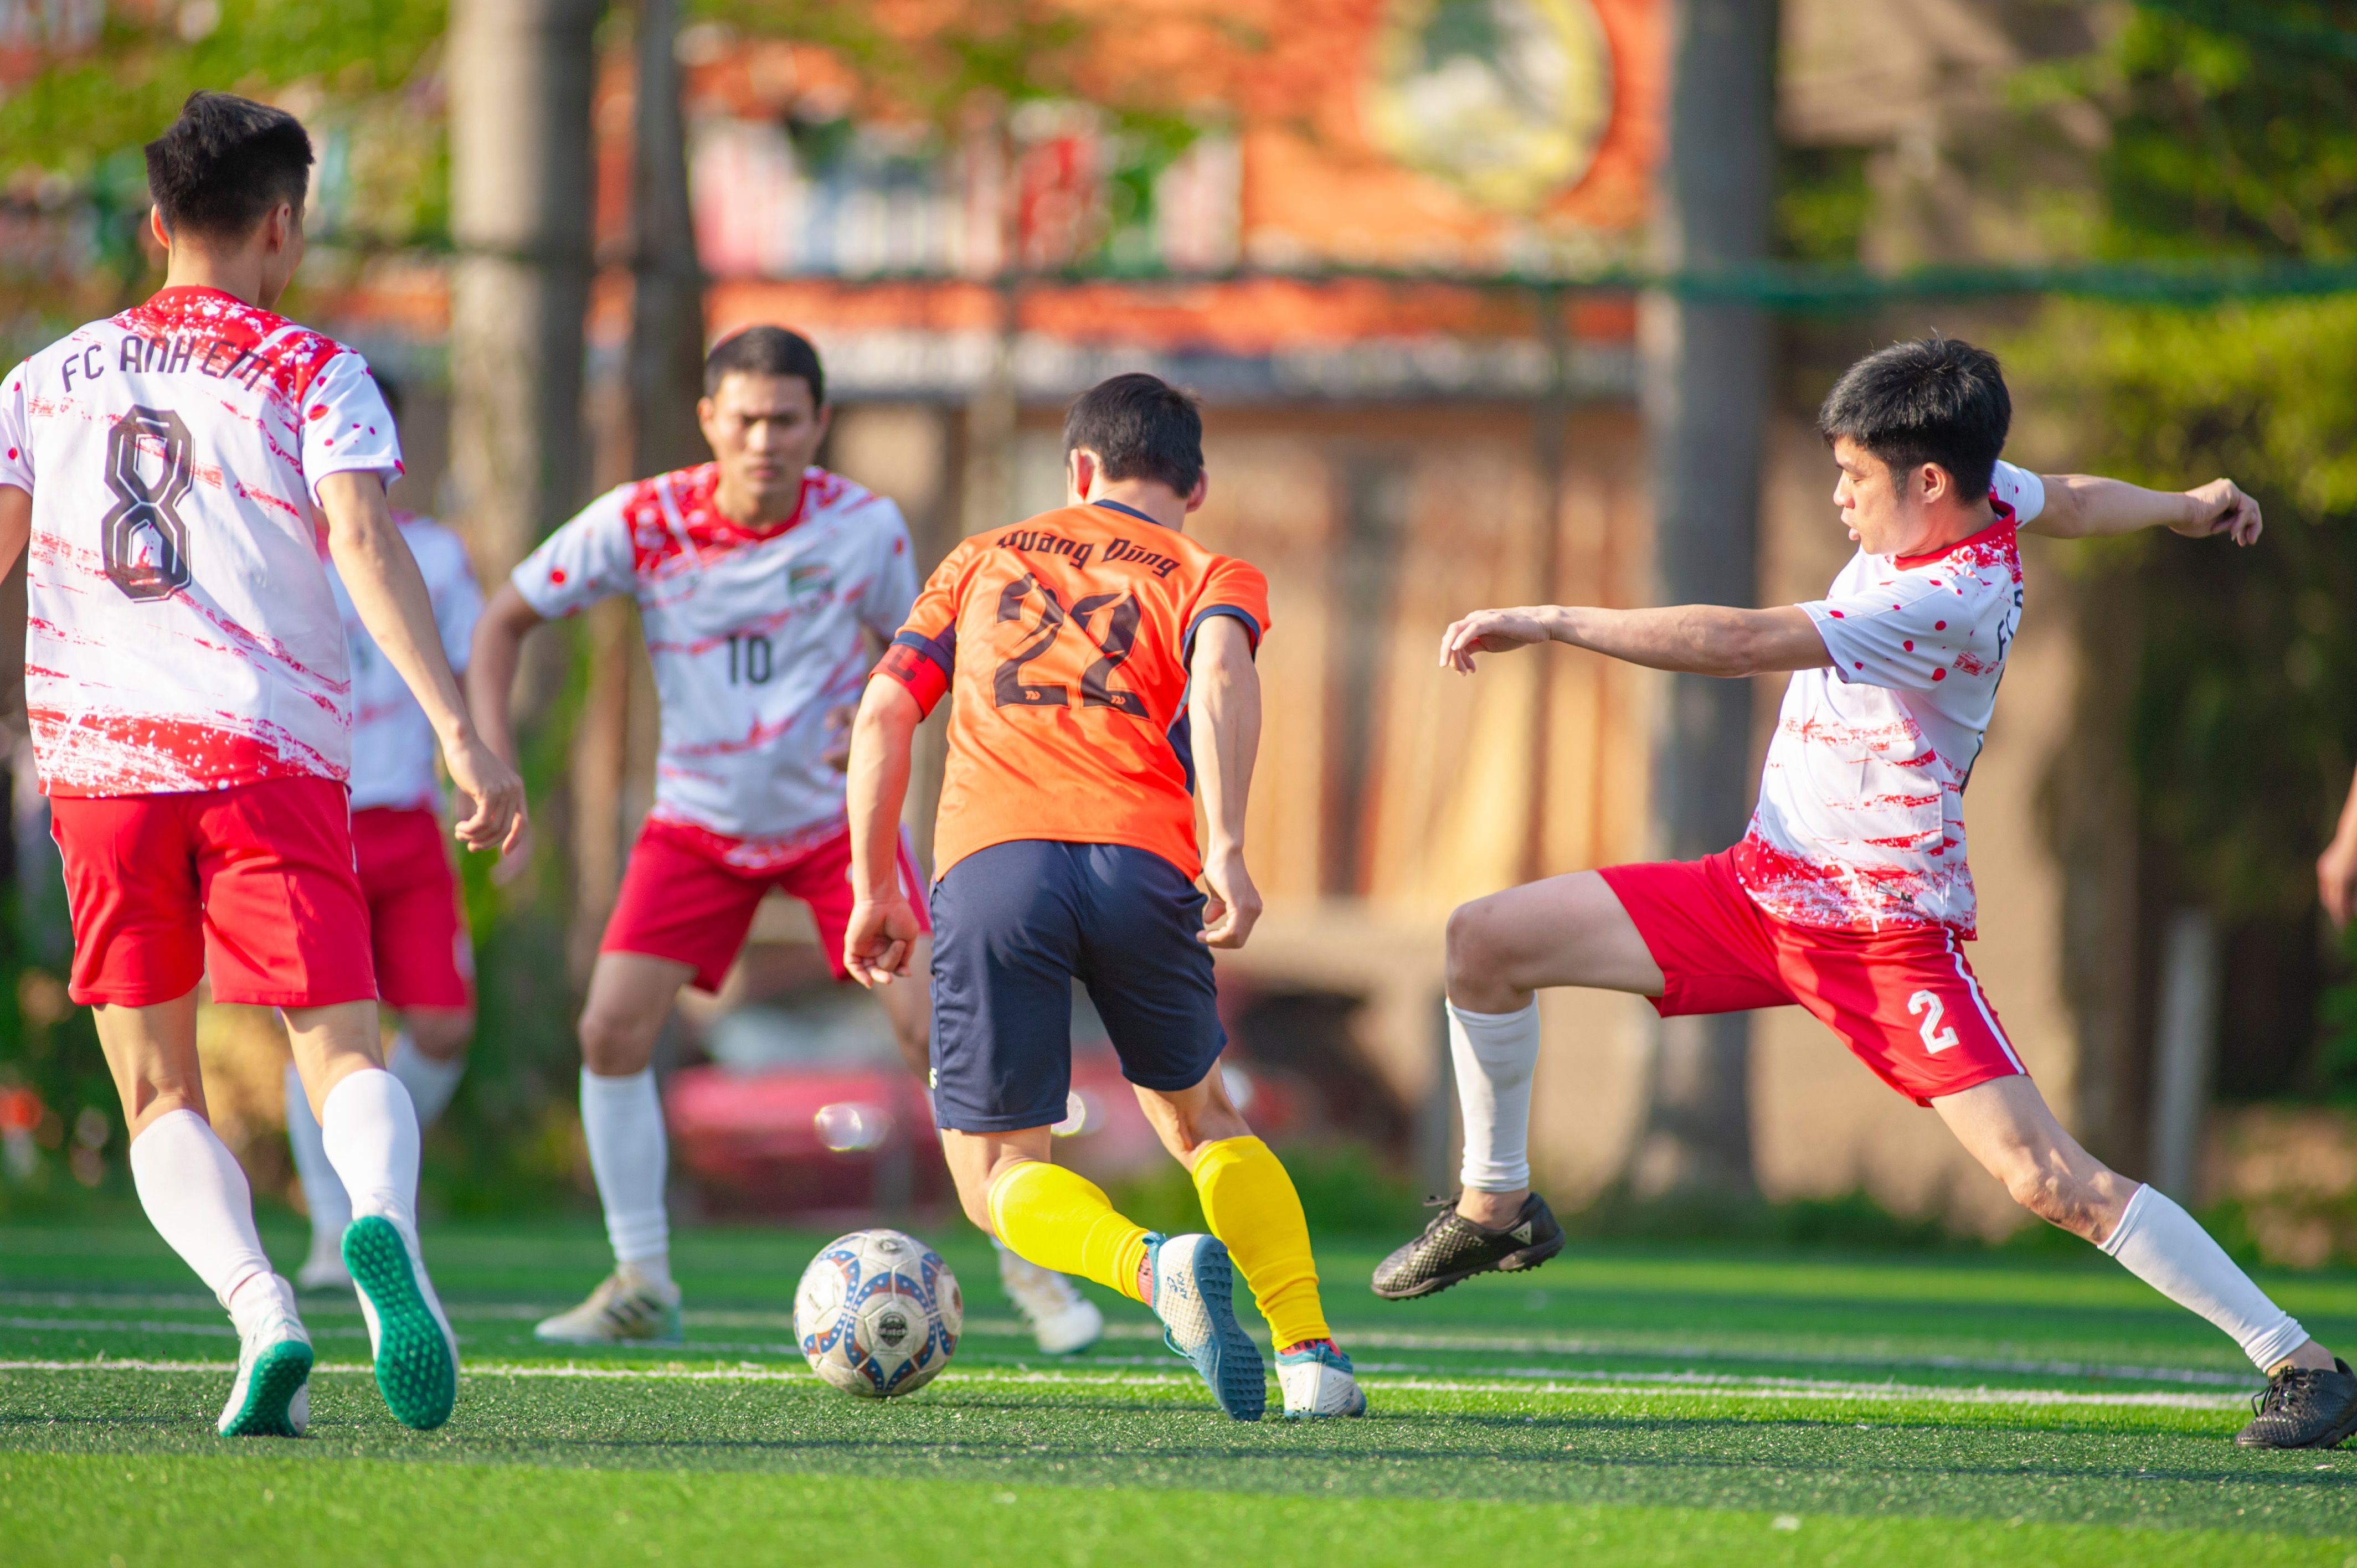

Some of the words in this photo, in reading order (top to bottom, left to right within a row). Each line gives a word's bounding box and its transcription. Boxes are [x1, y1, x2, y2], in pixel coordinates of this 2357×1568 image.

[63, 345, 104, 392] FC
[120, 336, 195, 373] ANH
[203, 340, 273, 391] EM
[102, 404, 195, 603] 8
[1102, 538, 1181, 578] Dũng
[725, 635, 772, 684] 10
[888, 644, 927, 681] C
[993, 572, 1152, 719] 22
[1908, 989, 1959, 1054] 2
